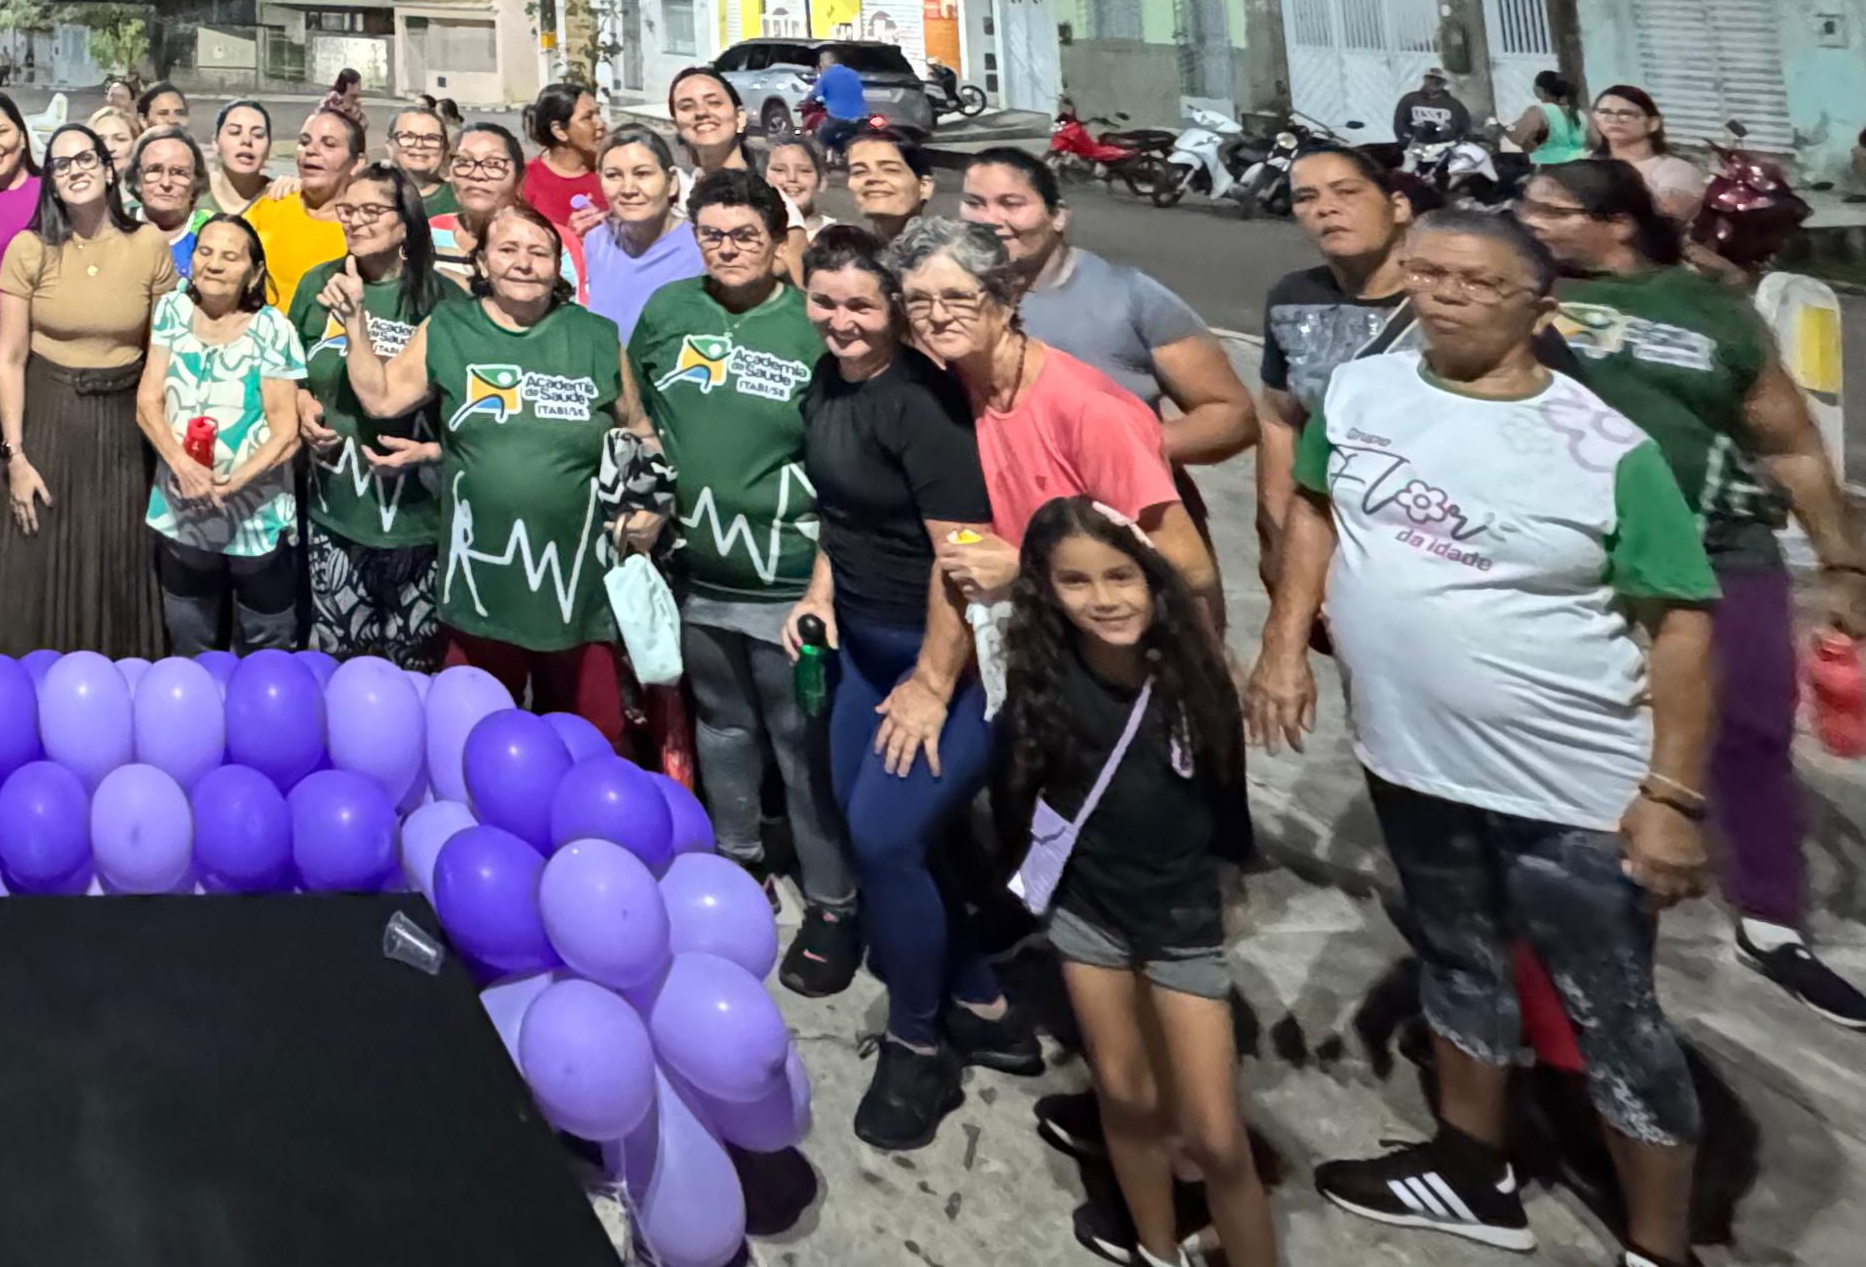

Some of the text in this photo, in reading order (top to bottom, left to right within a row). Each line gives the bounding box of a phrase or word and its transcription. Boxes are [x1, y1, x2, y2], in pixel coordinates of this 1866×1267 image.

[732, 349, 808, 378] Academia
[525, 375, 595, 396] Academia
[739, 380, 786, 397] ITABI/SE
[537, 405, 586, 417] ITABI/SE
[1426, 535, 1494, 572] idade
